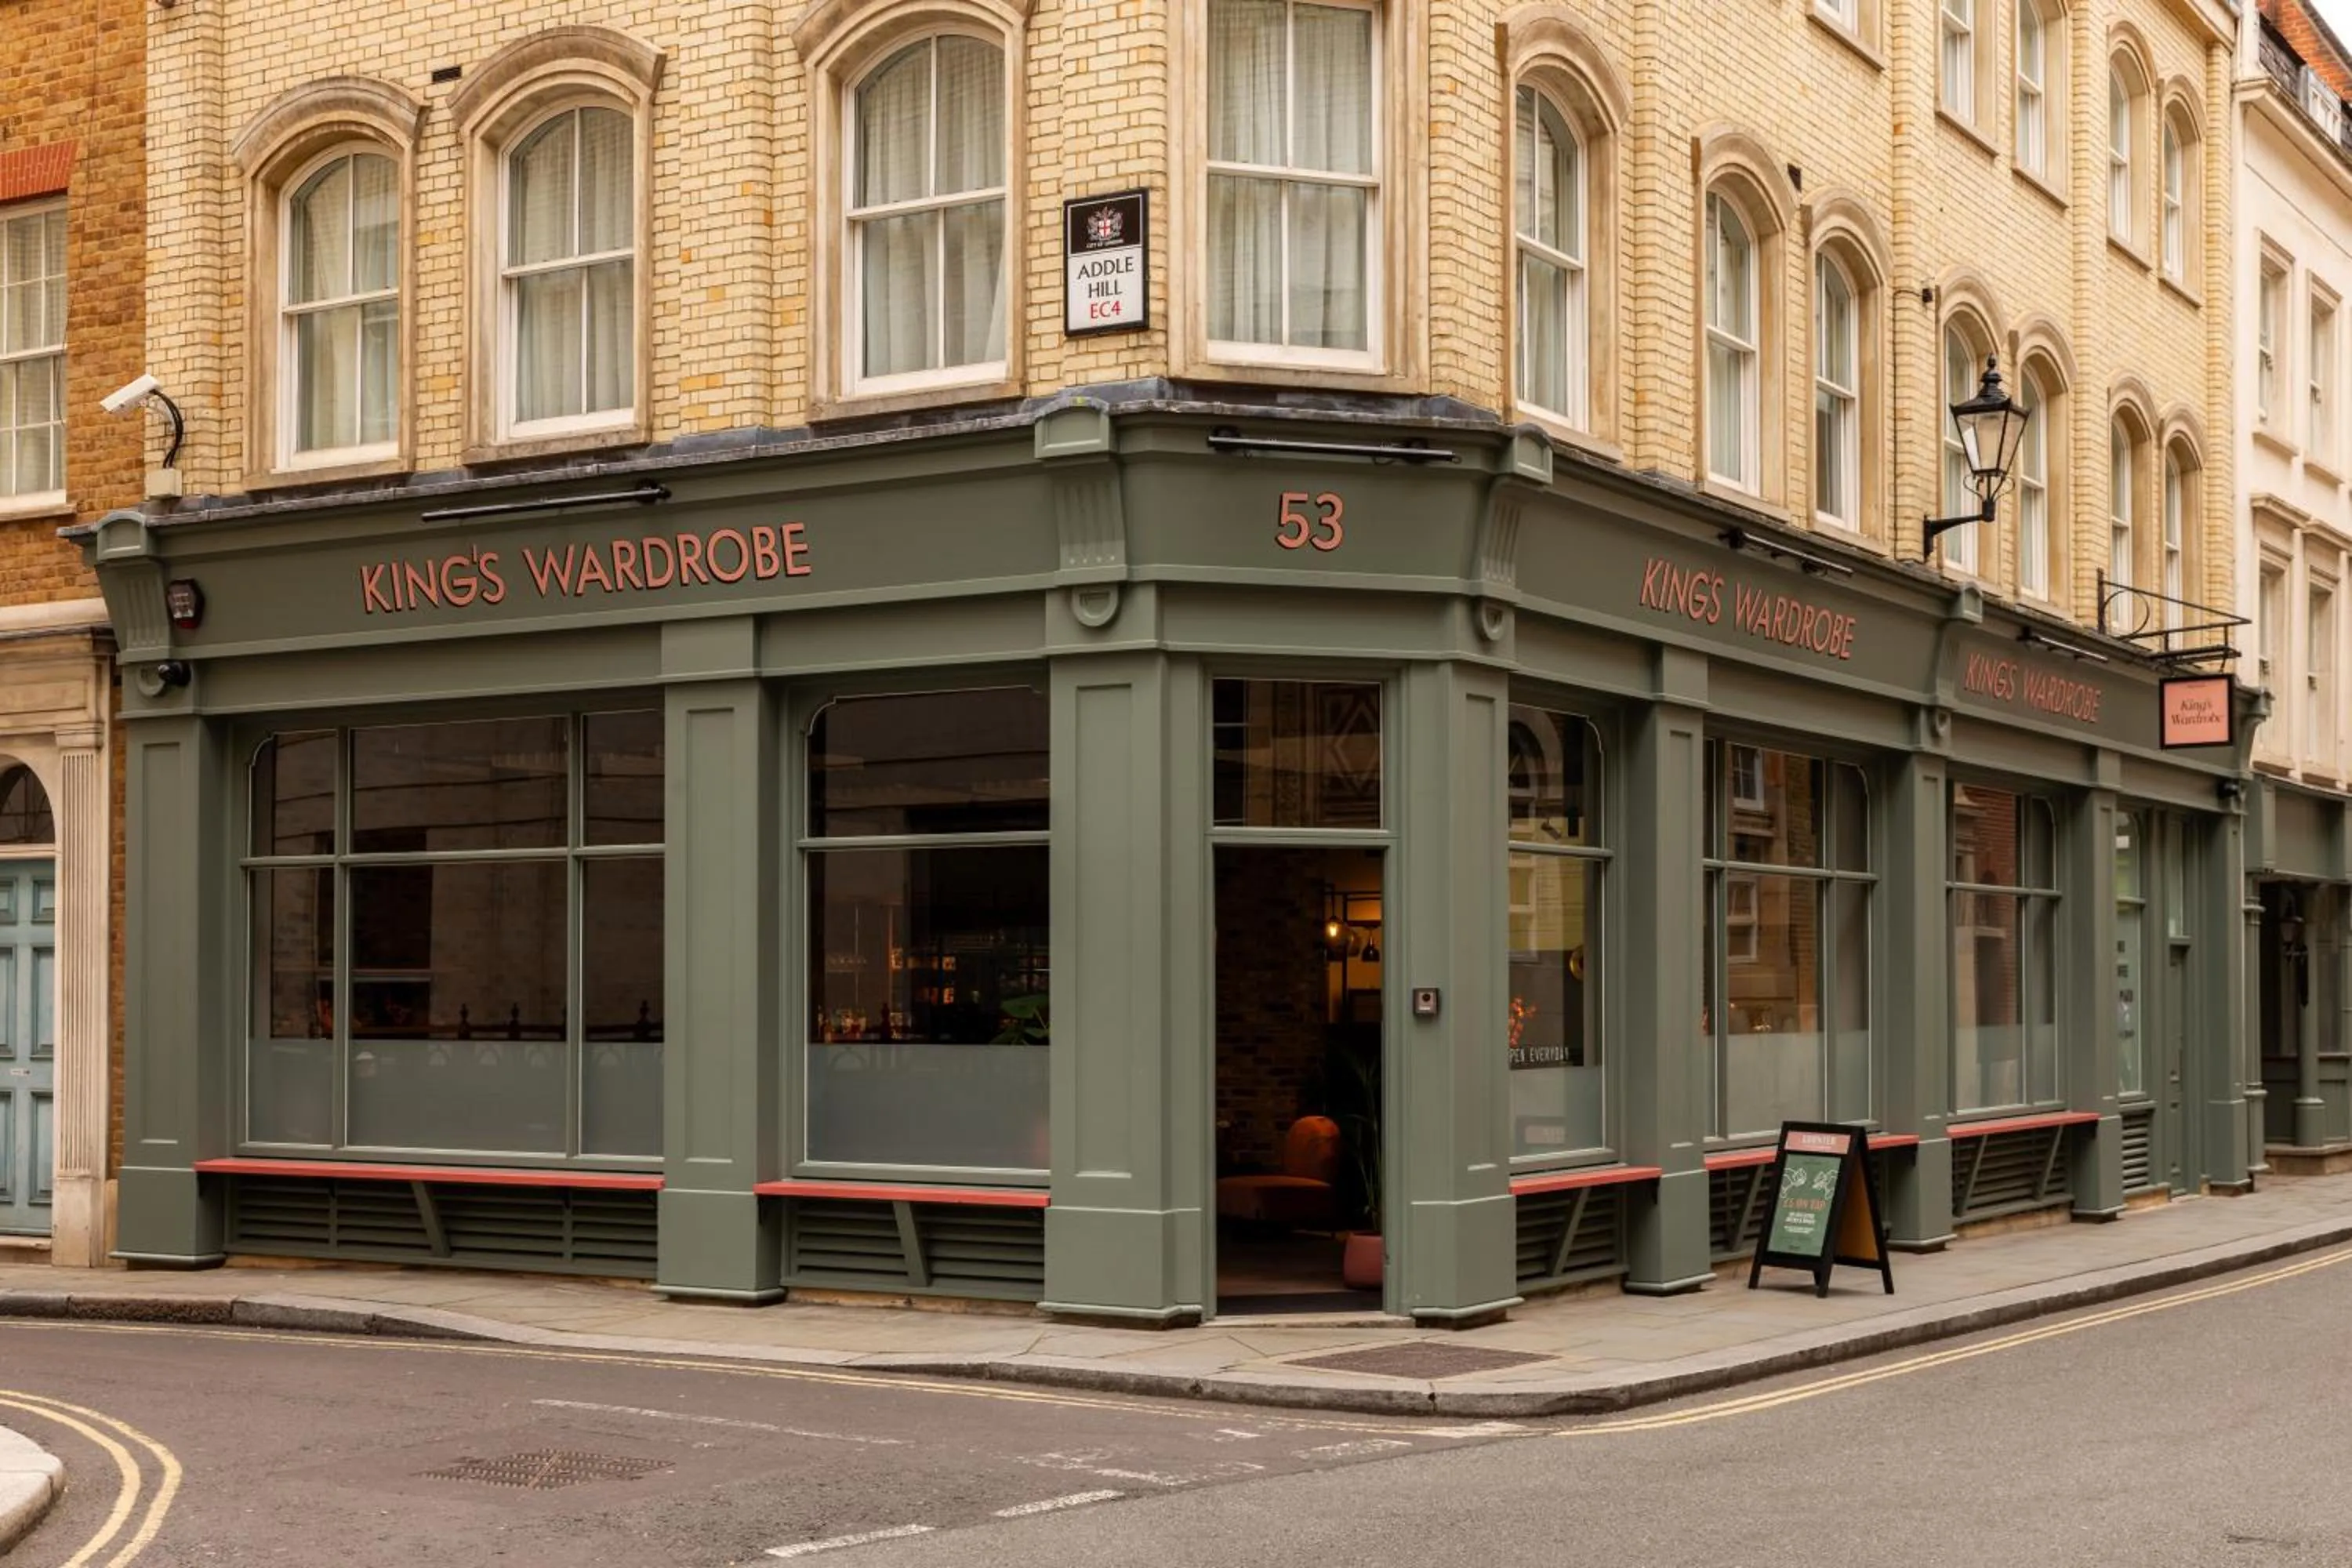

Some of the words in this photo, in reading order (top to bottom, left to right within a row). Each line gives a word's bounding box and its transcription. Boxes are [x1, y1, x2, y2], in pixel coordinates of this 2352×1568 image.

[1077, 256, 1134, 280] ADDLE
[1087, 279, 1123, 299] HILL
[1090, 300, 1122, 319] EC4
[1275, 492, 1344, 552] 53
[361, 543, 506, 613] KING'S
[523, 522, 812, 596] WARDROBE
[1639, 557, 1724, 625] KING'S
[1734, 580, 1857, 660] WARDROBE
[2024, 668, 2102, 723] WARDROBE
[1508, 1047, 1525, 1063] PEN
